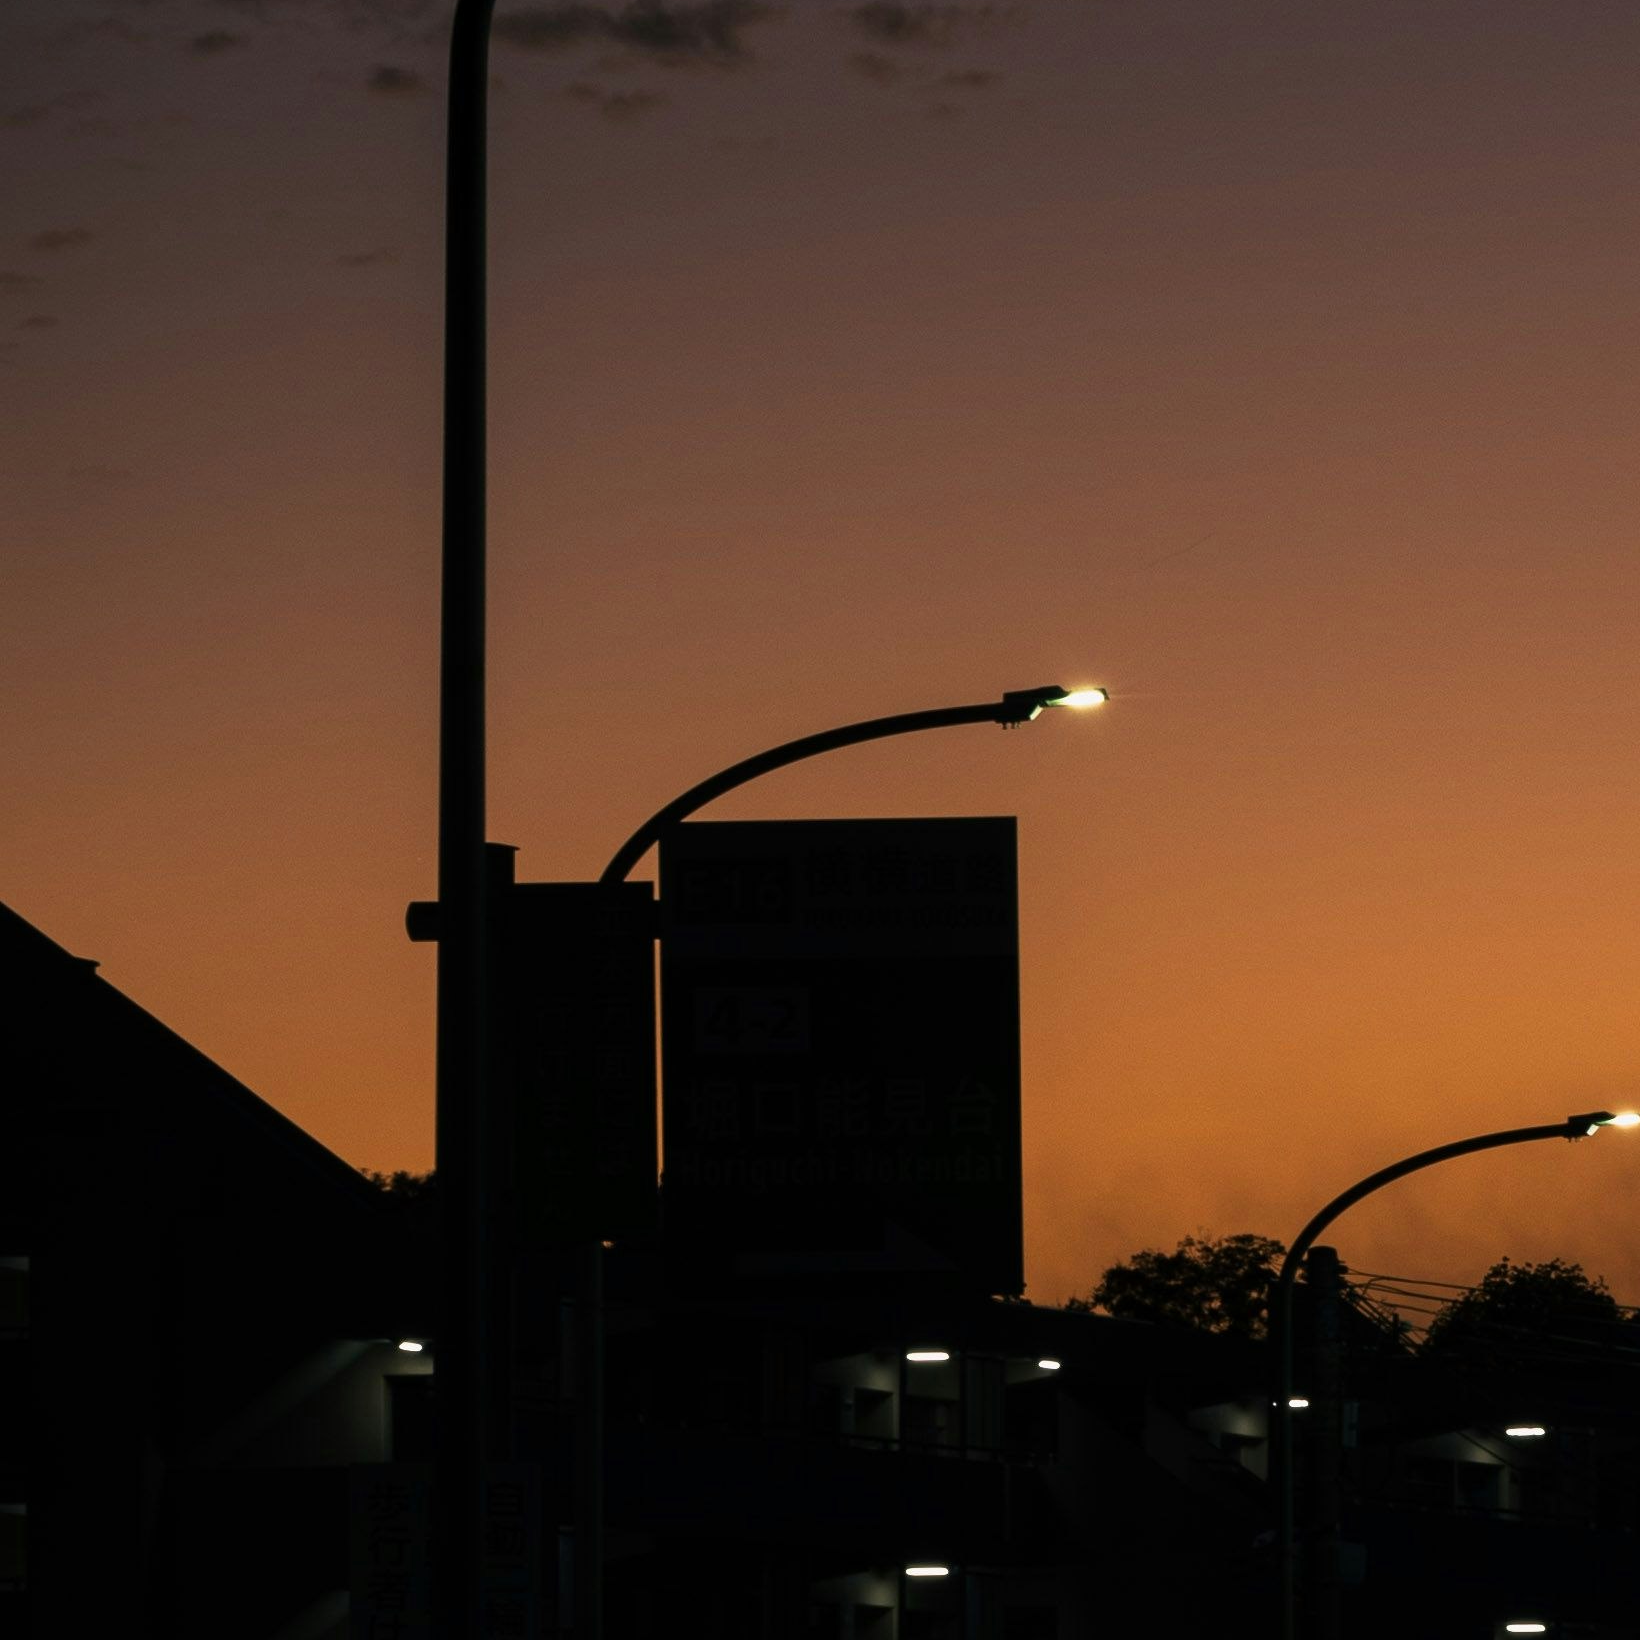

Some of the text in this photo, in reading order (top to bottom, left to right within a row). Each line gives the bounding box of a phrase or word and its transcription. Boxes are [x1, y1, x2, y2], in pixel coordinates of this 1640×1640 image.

[684, 862, 783, 912] E16
[704, 995, 799, 1046] 4-2
[681, 1072, 999, 1142] 堀口能見台
